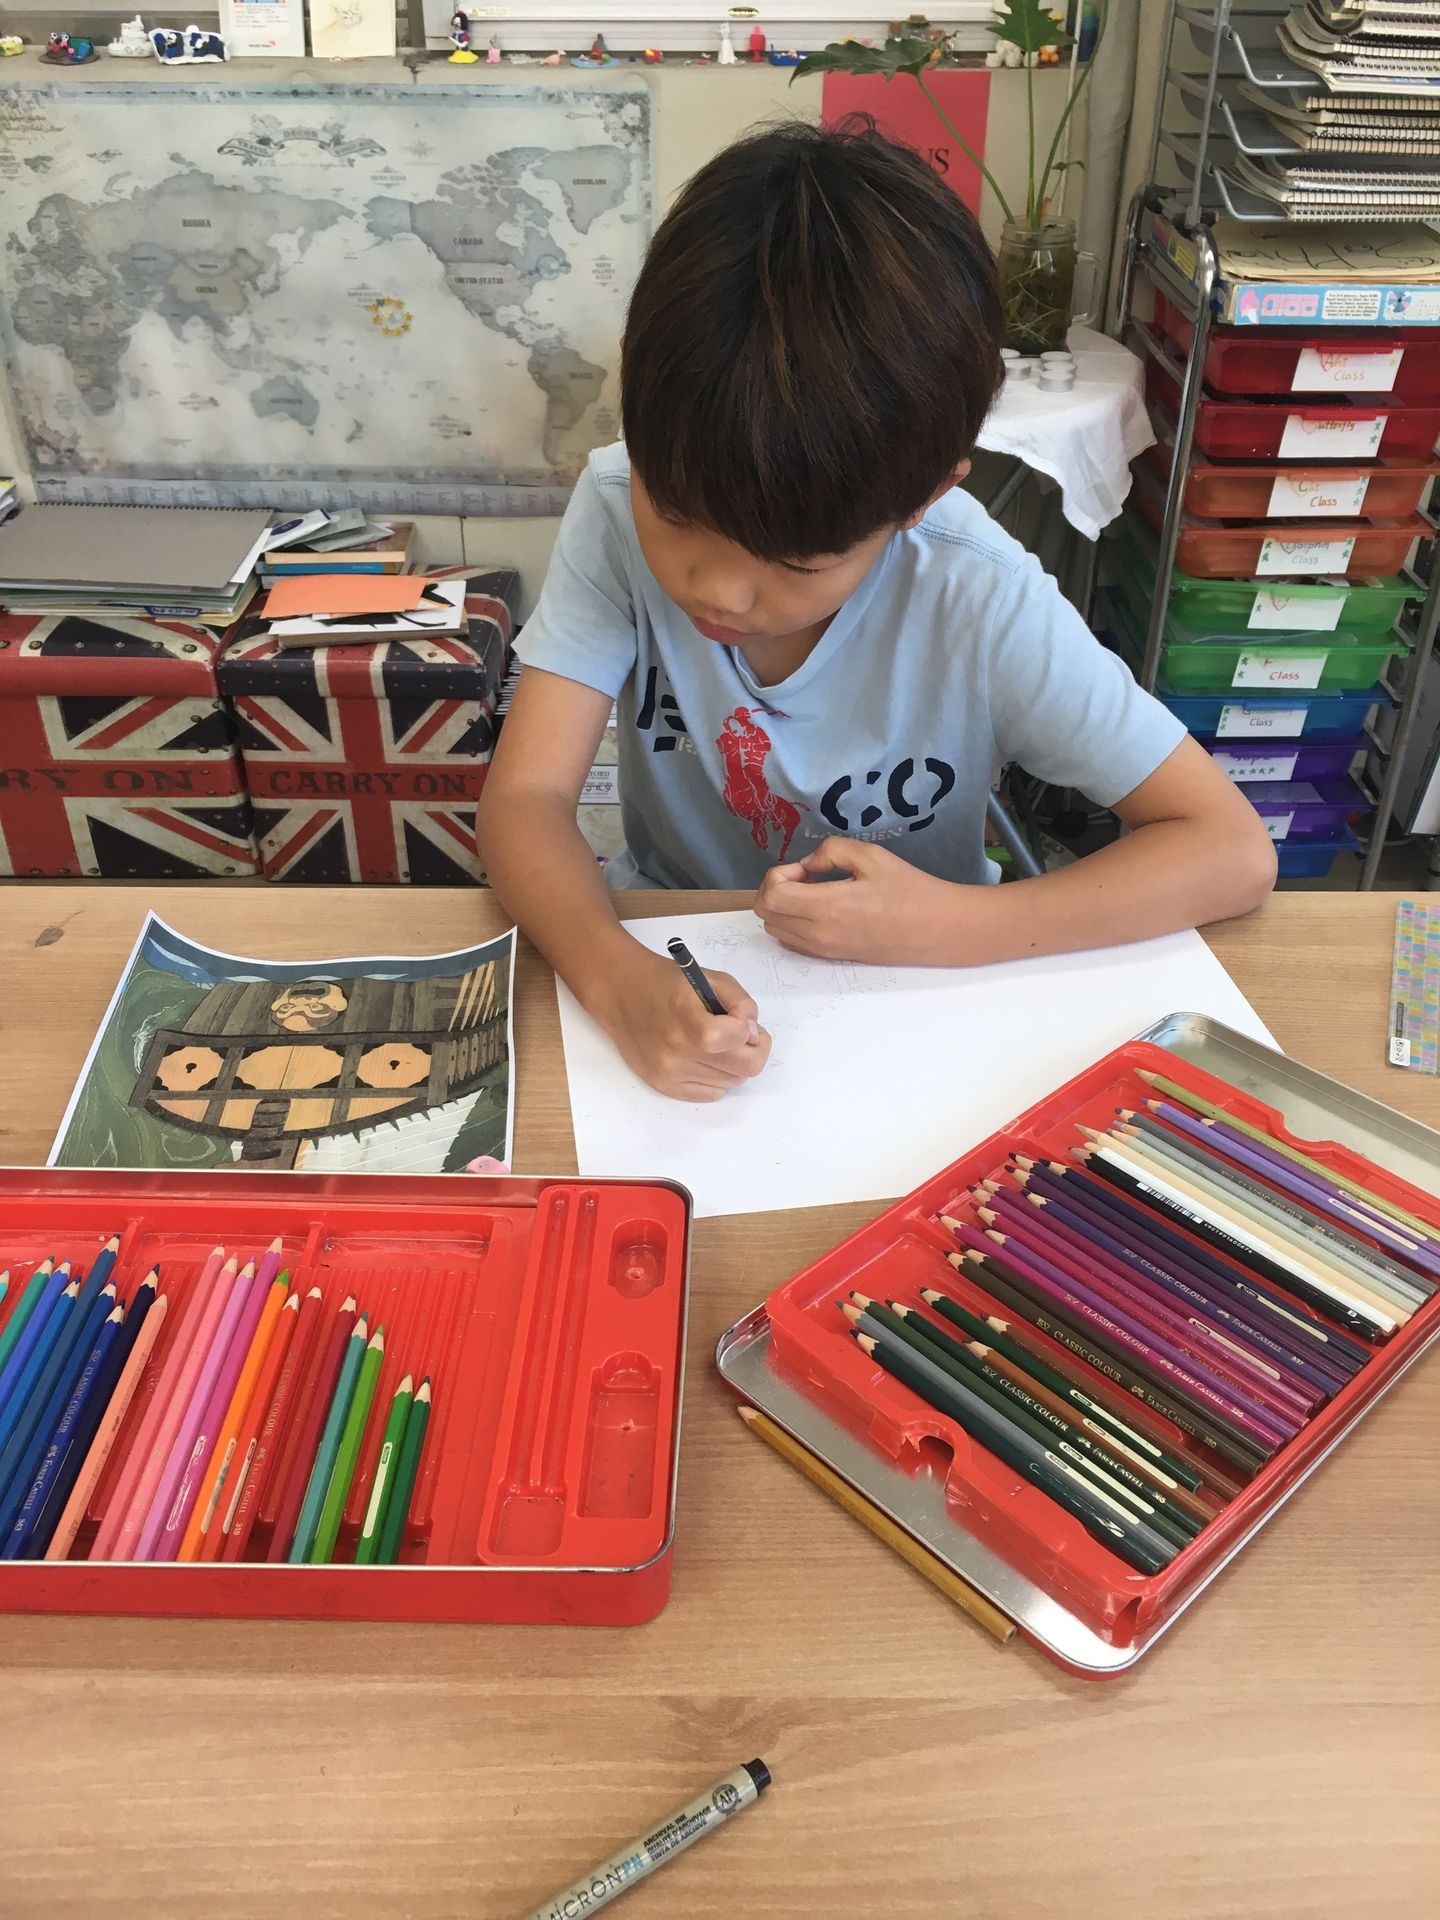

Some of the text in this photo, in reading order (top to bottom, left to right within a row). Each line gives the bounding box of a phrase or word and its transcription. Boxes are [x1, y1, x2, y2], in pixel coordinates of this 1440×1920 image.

[1310, 496, 1338, 507] Class
[1269, 671, 1300, 681] Class
[1249, 718, 1273, 727] Class
[103, 769, 193, 791] ON
[269, 770, 468, 796] CARRY ON
[1139, 1258, 1174, 1283] CLASSIC
[1172, 1279, 1208, 1305] COLOUR
[1081, 1303, 1116, 1331] CLASSIC
[1114, 1326, 1150, 1355] COLOUR
[1052, 1329, 1089, 1358] CLASSIC
[1086, 1353, 1123, 1382] COLOUR
[57, 1398, 79, 1434] COLOUR
[997, 1377, 1035, 1407] CLASSIC
[1032, 1401, 1070, 1432] COLOUR
[641, 1822, 675, 1847] ARCHIVAL
[669, 1837, 680, 1848] DE
[678, 1818, 708, 1841] ARCHIVE
